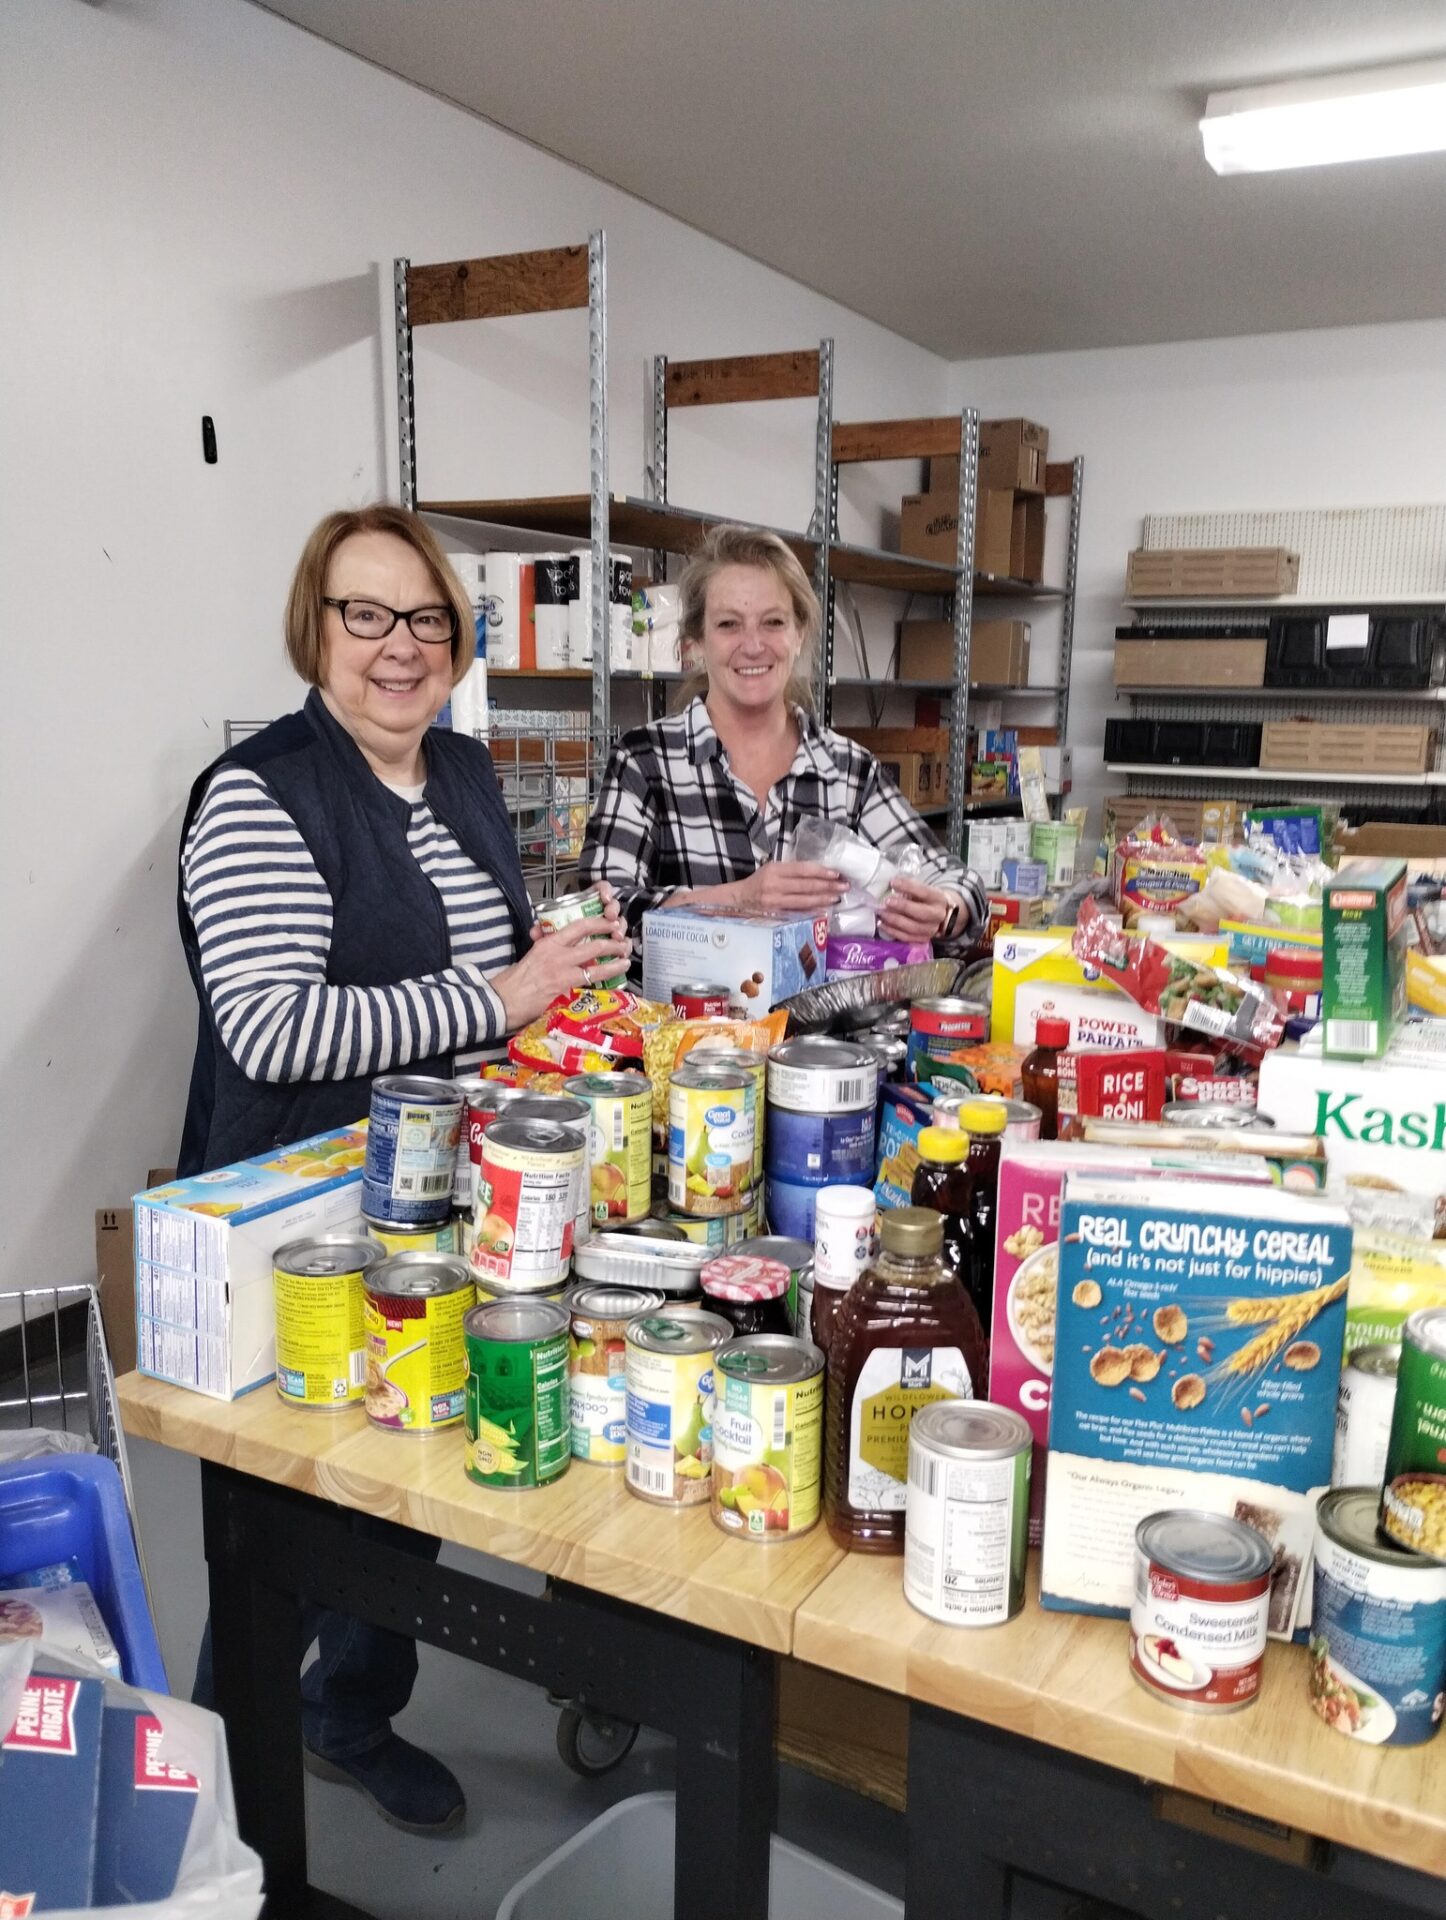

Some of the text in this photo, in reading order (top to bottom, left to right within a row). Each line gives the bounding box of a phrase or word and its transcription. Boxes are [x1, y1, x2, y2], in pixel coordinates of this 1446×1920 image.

[646, 926, 709, 943] LOADED HOT COCOA
[1079, 1016, 1138, 1036] POWER
[1103, 1071, 1144, 1095] RICE
[1181, 1077, 1255, 1095] Snack
[1103, 1101, 1144, 1121] RONI
[731, 1127, 755, 1140] Cock
[1087, 1247, 1322, 1288] (and it's not just for hippies)
[885, 1393, 946, 1402] WILDFLOWER
[873, 1404, 924, 1421] HON
[731, 1417, 752, 1432] Fruit
[1076, 1410, 1088, 1419] The
[1110, 1415, 1121, 1424] for
[1233, 1430, 1254, 1440] blend
[1254, 1431, 1263, 1440] of
[1263, 1433, 1288, 1443] organic
[1109, 1426, 1122, 1434] and
[1156, 1431, 1167, 1440] for
[866, 1435, 908, 1443] PREMIU
[1129, 1438, 1144, 1448] And
[1144, 1440, 1160, 1449] with
[1171, 1453, 1190, 1463] good
[1190, 1456, 1215, 1466] organic
[1215, 1457, 1233, 1468] food
[1090, 1475, 1119, 1487] Always
[1121, 1479, 1153, 1491] Organic
[1156, 1484, 1185, 1496] Legacy
[944, 1574, 958, 1586] 20
[944, 1602, 1003, 1613] Nutrition Facts
[1189, 1608, 1259, 1628] Sweetened
[1154, 1614, 1258, 1643] Condensed Milk
[16, 1688, 42, 1737] PENNE
[40, 1689, 66, 1741] RIGATE
